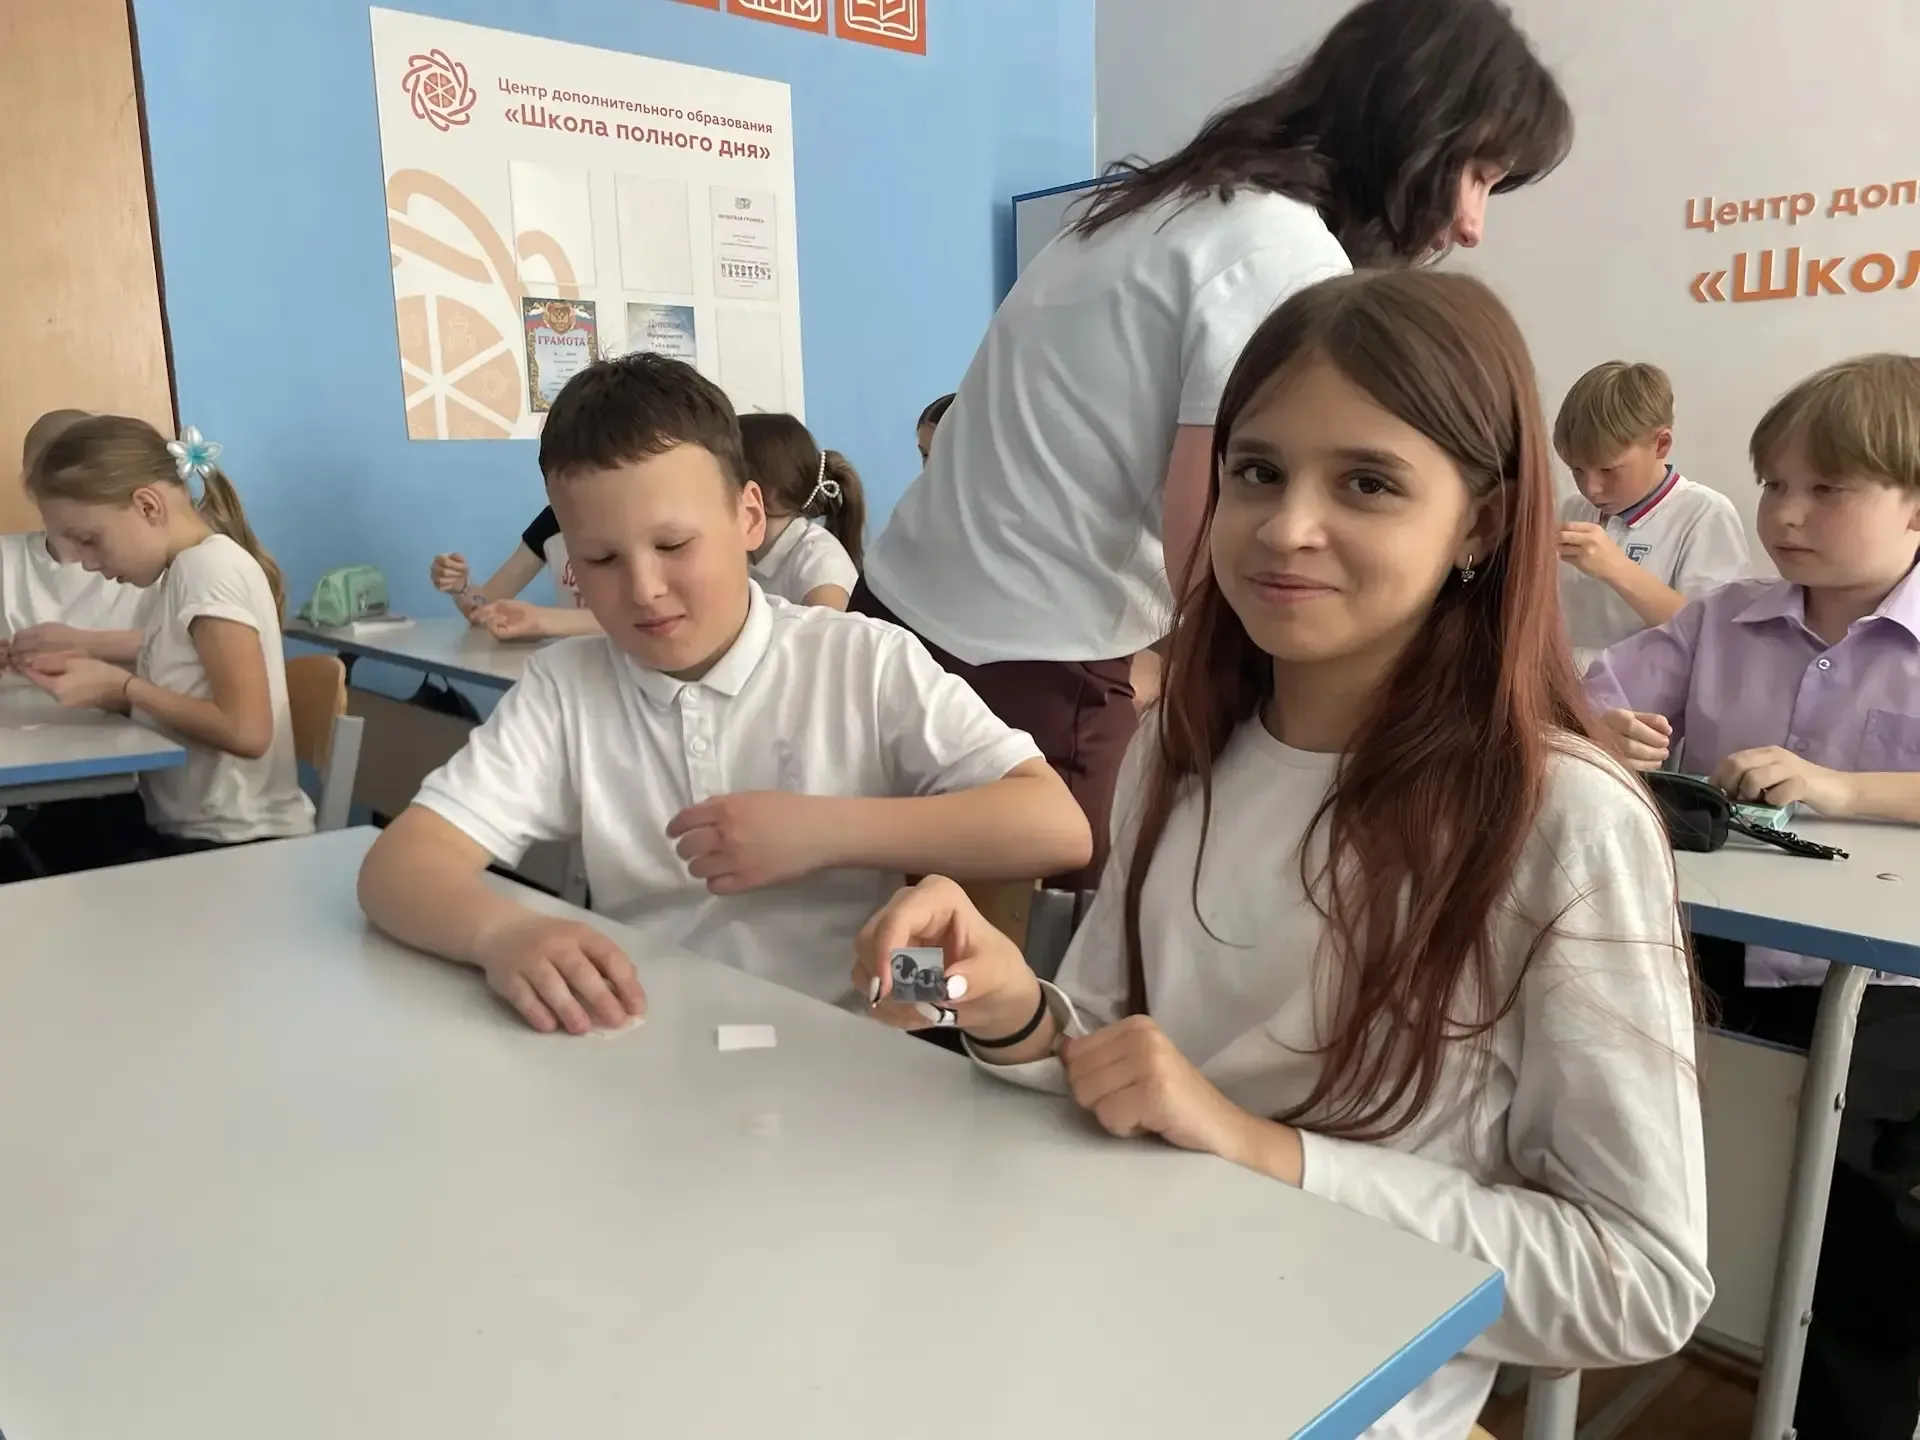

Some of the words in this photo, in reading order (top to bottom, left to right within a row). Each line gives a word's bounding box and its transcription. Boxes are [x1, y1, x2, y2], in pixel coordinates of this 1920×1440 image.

[497, 77, 548, 101] Центр
[552, 89, 684, 120] дополнительного
[687, 110, 773, 134] образования
[504, 103, 610, 138] «Школа
[616, 124, 713, 152] полного
[718, 139, 771, 160] дня»
[1684, 192, 1817, 233] Центр
[1825, 180, 1920, 219] доп
[537, 335, 586, 347] ГРАМОТА
